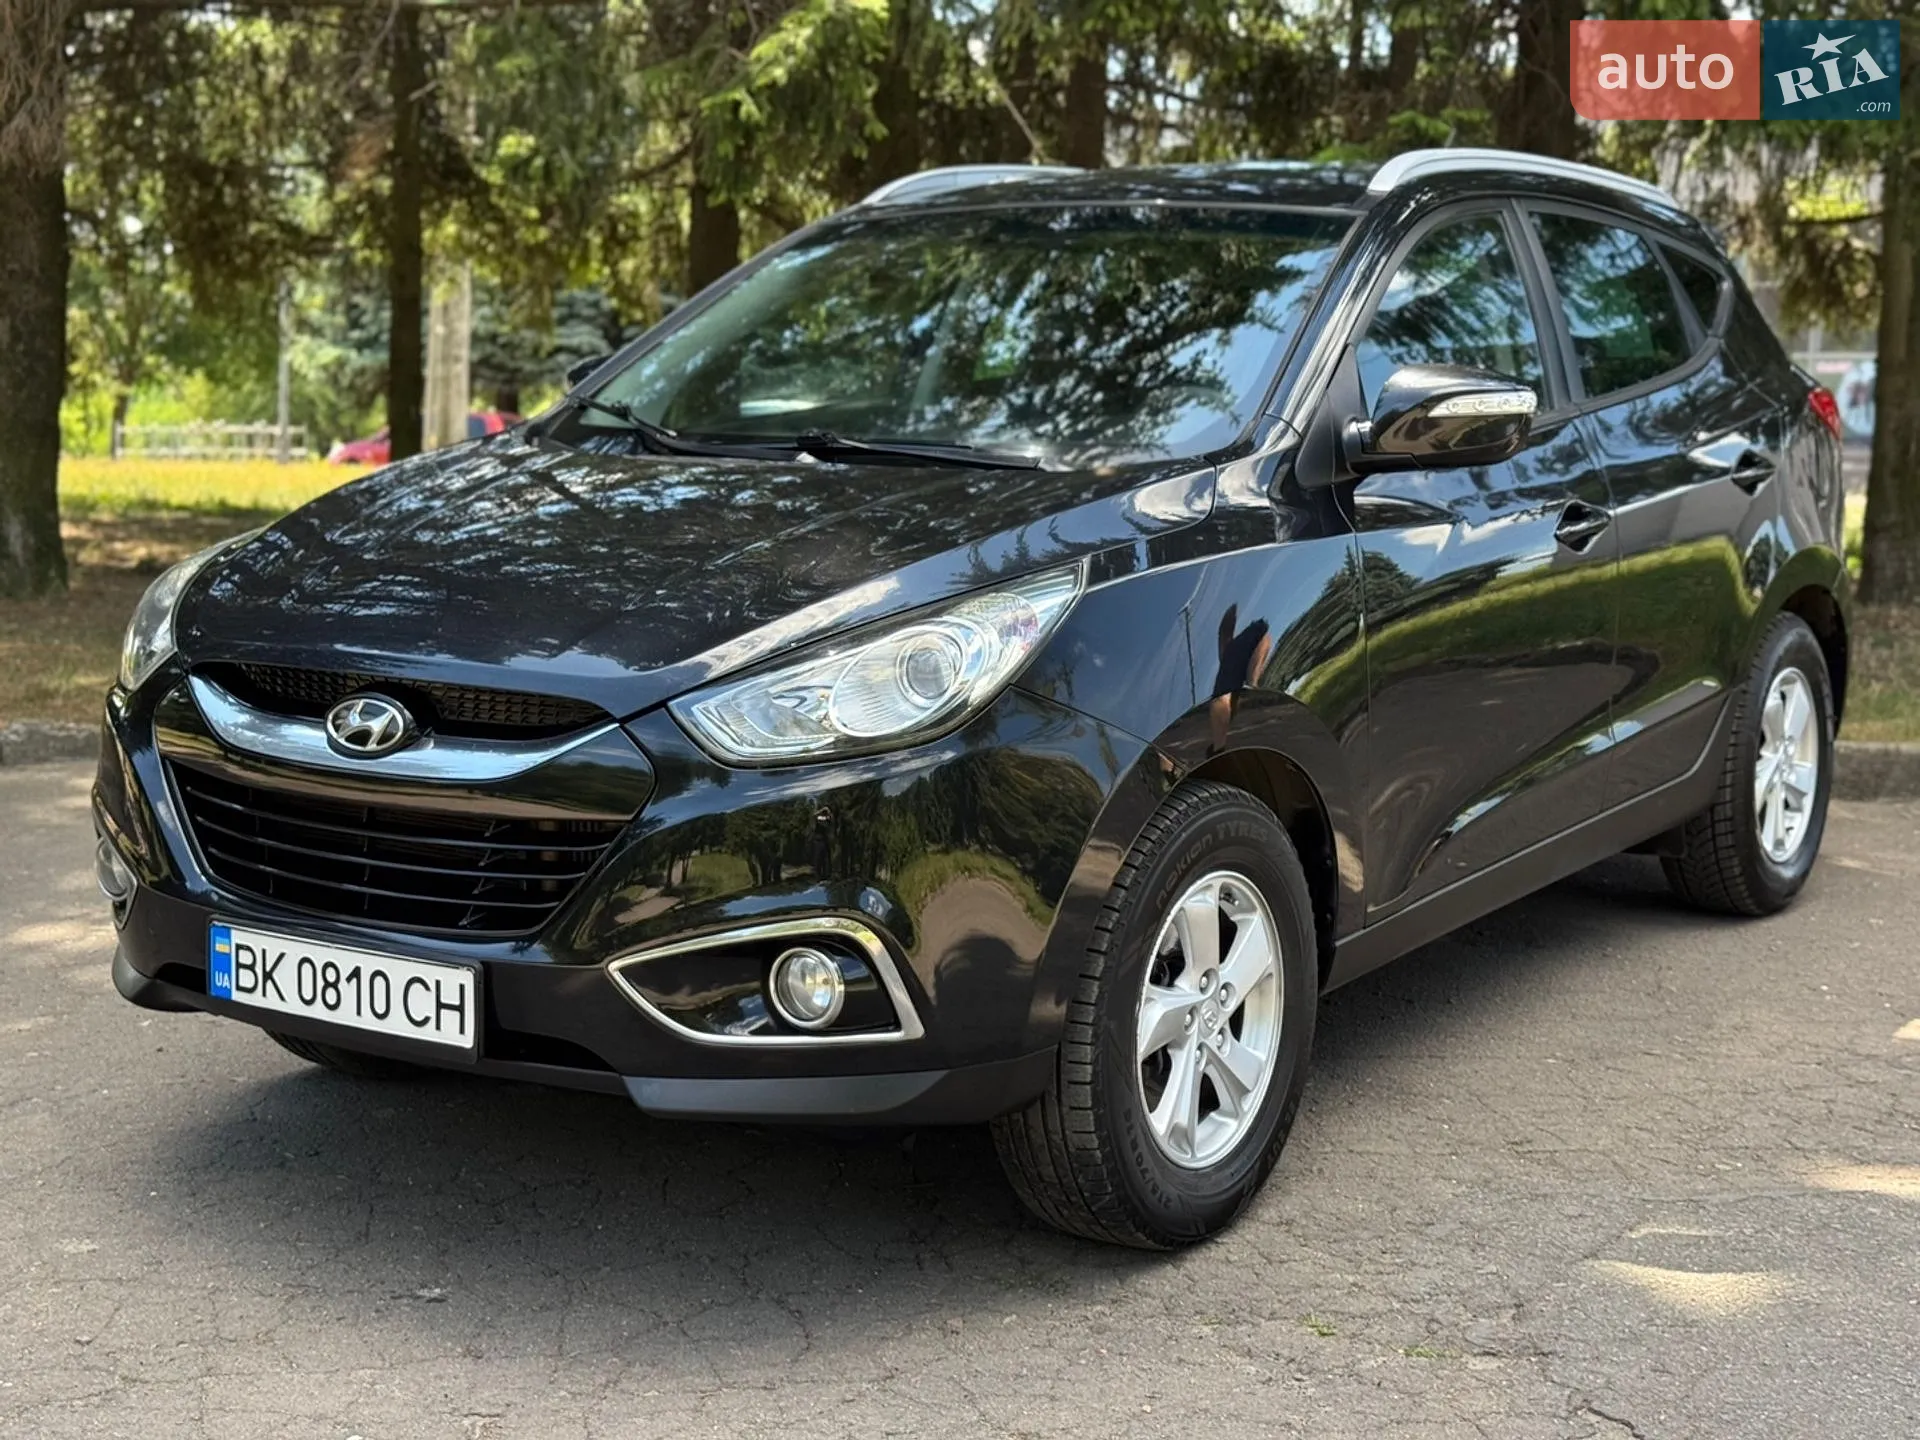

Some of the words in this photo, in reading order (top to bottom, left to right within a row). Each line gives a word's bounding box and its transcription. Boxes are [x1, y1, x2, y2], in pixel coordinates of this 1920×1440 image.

[215, 971, 230, 989] UA
[234, 942, 287, 1003] BK
[297, 956, 391, 1020] 0810
[403, 976, 466, 1035] CH
